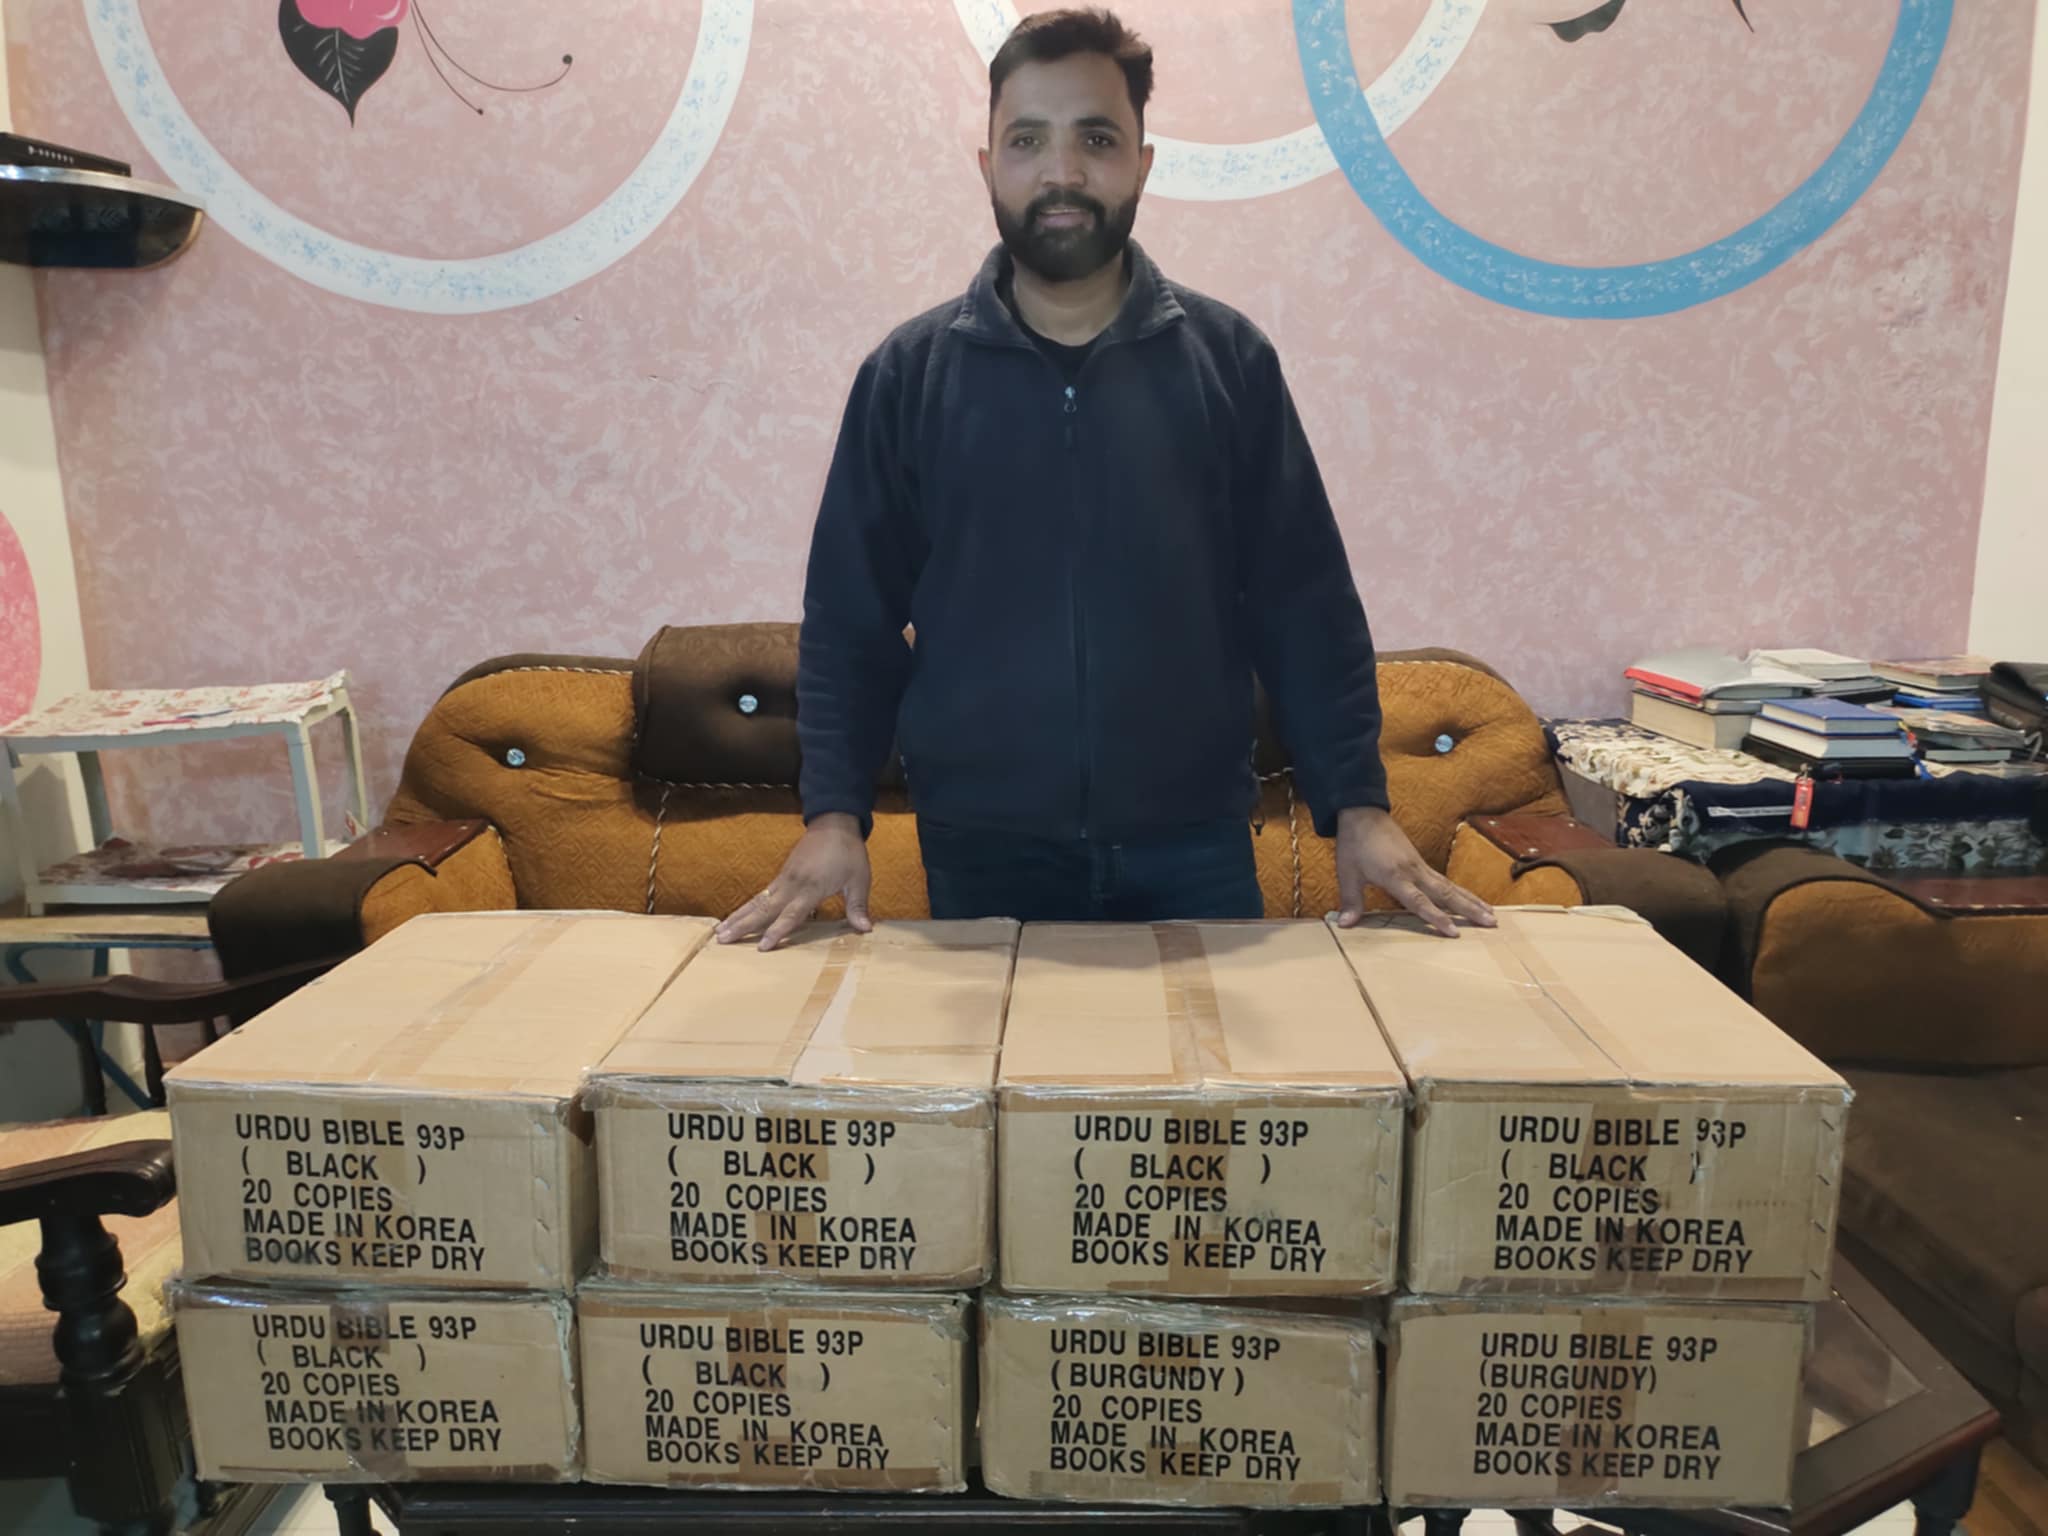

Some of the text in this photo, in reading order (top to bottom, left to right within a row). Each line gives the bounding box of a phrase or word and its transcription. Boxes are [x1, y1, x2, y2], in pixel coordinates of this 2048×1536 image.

[236, 1113, 465, 1151] URDU BIBLE 93P
[668, 1113, 896, 1147] URDU BIBLE 93P
[1075, 1115, 1309, 1147] URDU BIBLE 93P
[1500, 1116, 1746, 1148] URDU BIBLE 93P
[287, 1151, 379, 1180] BLACK
[724, 1150, 816, 1178] BLACK
[1131, 1154, 1225, 1181] BLACK
[1549, 1154, 1648, 1181] BLACK
[243, 1179, 393, 1212] 20 COPIES
[671, 1182, 827, 1213] 20 COPIES
[1075, 1184, 1227, 1212] 20 COPIES
[1499, 1184, 1658, 1214] 20 COPIES
[244, 1209, 476, 1244] MADE IN KOREA
[670, 1212, 917, 1243] MADE IN KOREA
[1073, 1213, 1321, 1246] MADE IN KOREA
[1496, 1215, 1745, 1246] MADE IN KOREA
[246, 1237, 485, 1271] BOOKS KEEP DRY
[671, 1240, 916, 1270] BOOKS KEEP DRY
[1072, 1240, 1327, 1273] BOOKS KEEP DRY
[1495, 1246, 1753, 1273] BOOKS KEEP DRY
[253, 1315, 476, 1340] URDU BIBLE 93P
[640, 1324, 863, 1356] URDU BIBLE 93P
[293, 1346, 383, 1368] BLACK
[1051, 1330, 1280, 1361] URDU BIBLE 93P
[1481, 1333, 1717, 1362] URDU BIBLE 93P
[261, 1372, 400, 1397] 20 COPIES
[696, 1361, 786, 1388] BLACK
[265, 1400, 498, 1424] MADE IN KOREA
[645, 1390, 791, 1417] 20 COPIES
[1053, 1395, 1202, 1423] 20 COPIES
[1477, 1393, 1622, 1420] 20 COPIES
[269, 1427, 501, 1452] BOOKS KEEP DRY
[645, 1416, 884, 1447] MADE IN KOREA
[1051, 1421, 1295, 1455] MADE IN KOREA
[1475, 1422, 1720, 1451] MADE IN KOREA
[647, 1441, 889, 1471] BOOKS KEEP DRY
[1050, 1447, 1301, 1481] BOOKS KEEP DRY
[1474, 1451, 1721, 1480] BOOKS KEEP DRY
